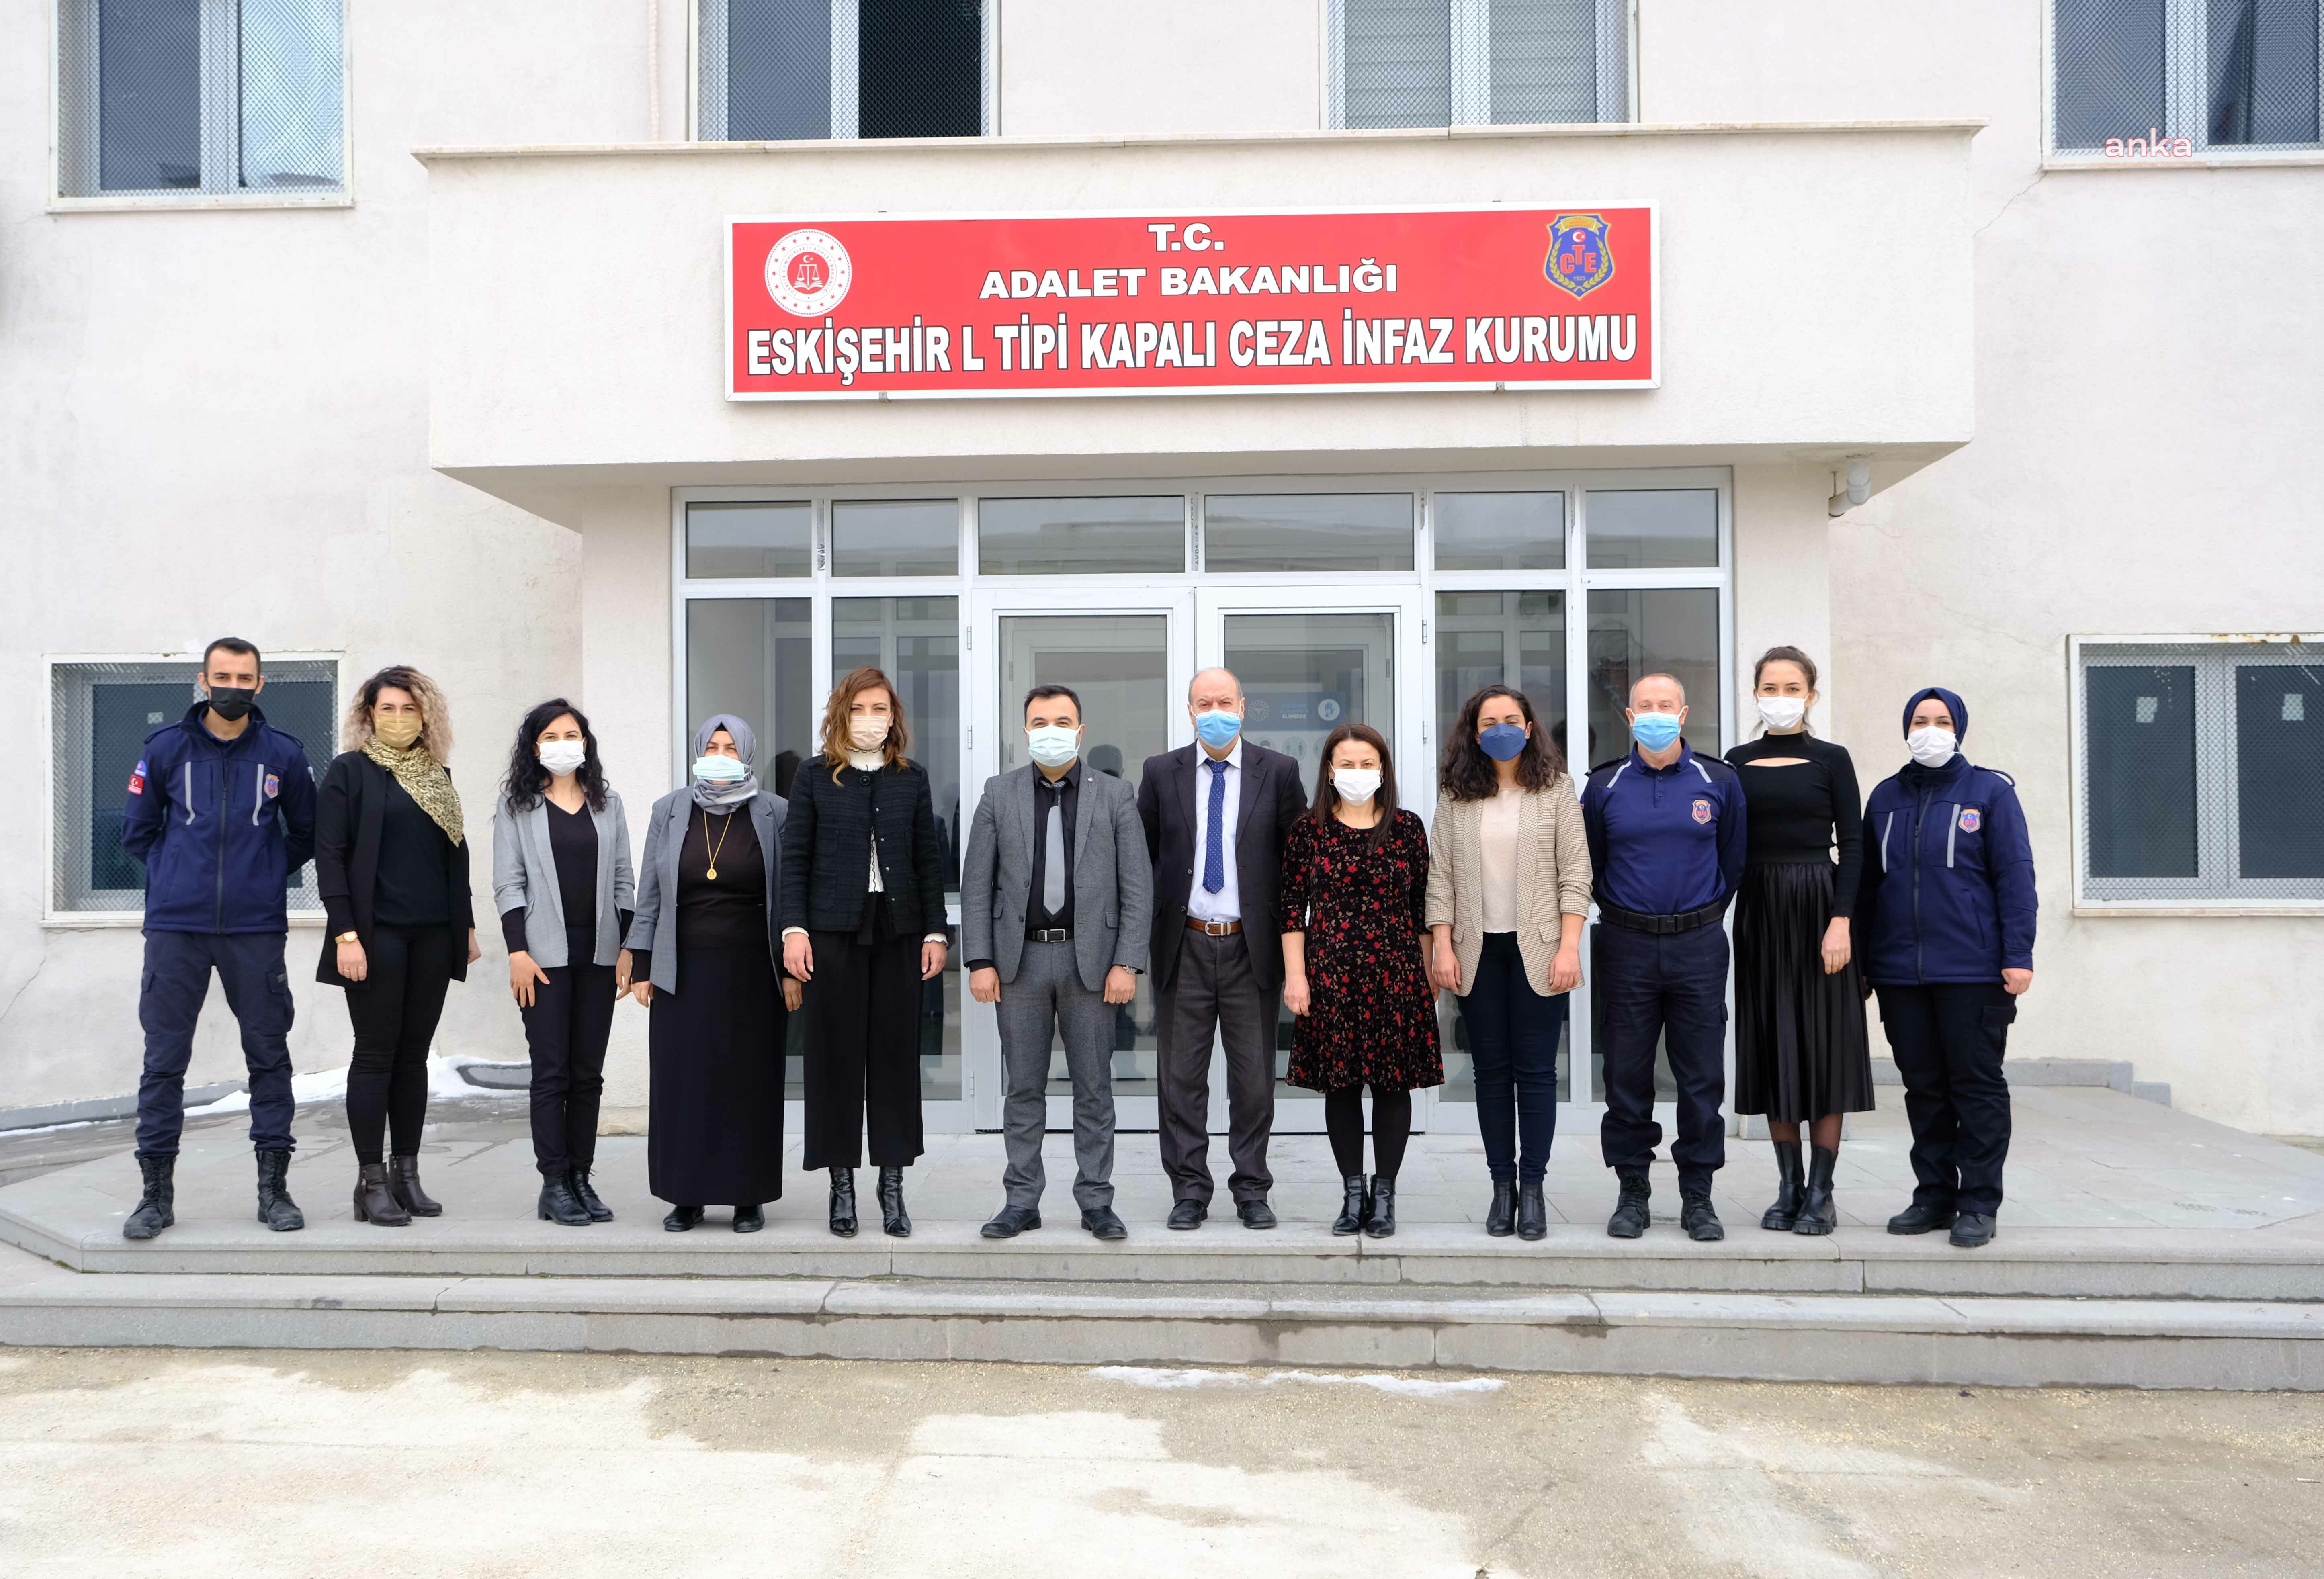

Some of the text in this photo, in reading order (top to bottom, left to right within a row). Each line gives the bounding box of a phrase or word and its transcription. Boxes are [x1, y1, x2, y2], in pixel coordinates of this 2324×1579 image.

[1147, 222, 1224, 252] T.C.
[978, 257, 1397, 299] ADALET BAKANLIĞI
[747, 307, 1637, 386] ESKİŞEHİR L TİPİ KAPALI CEZA İNFAZ KURUMU
